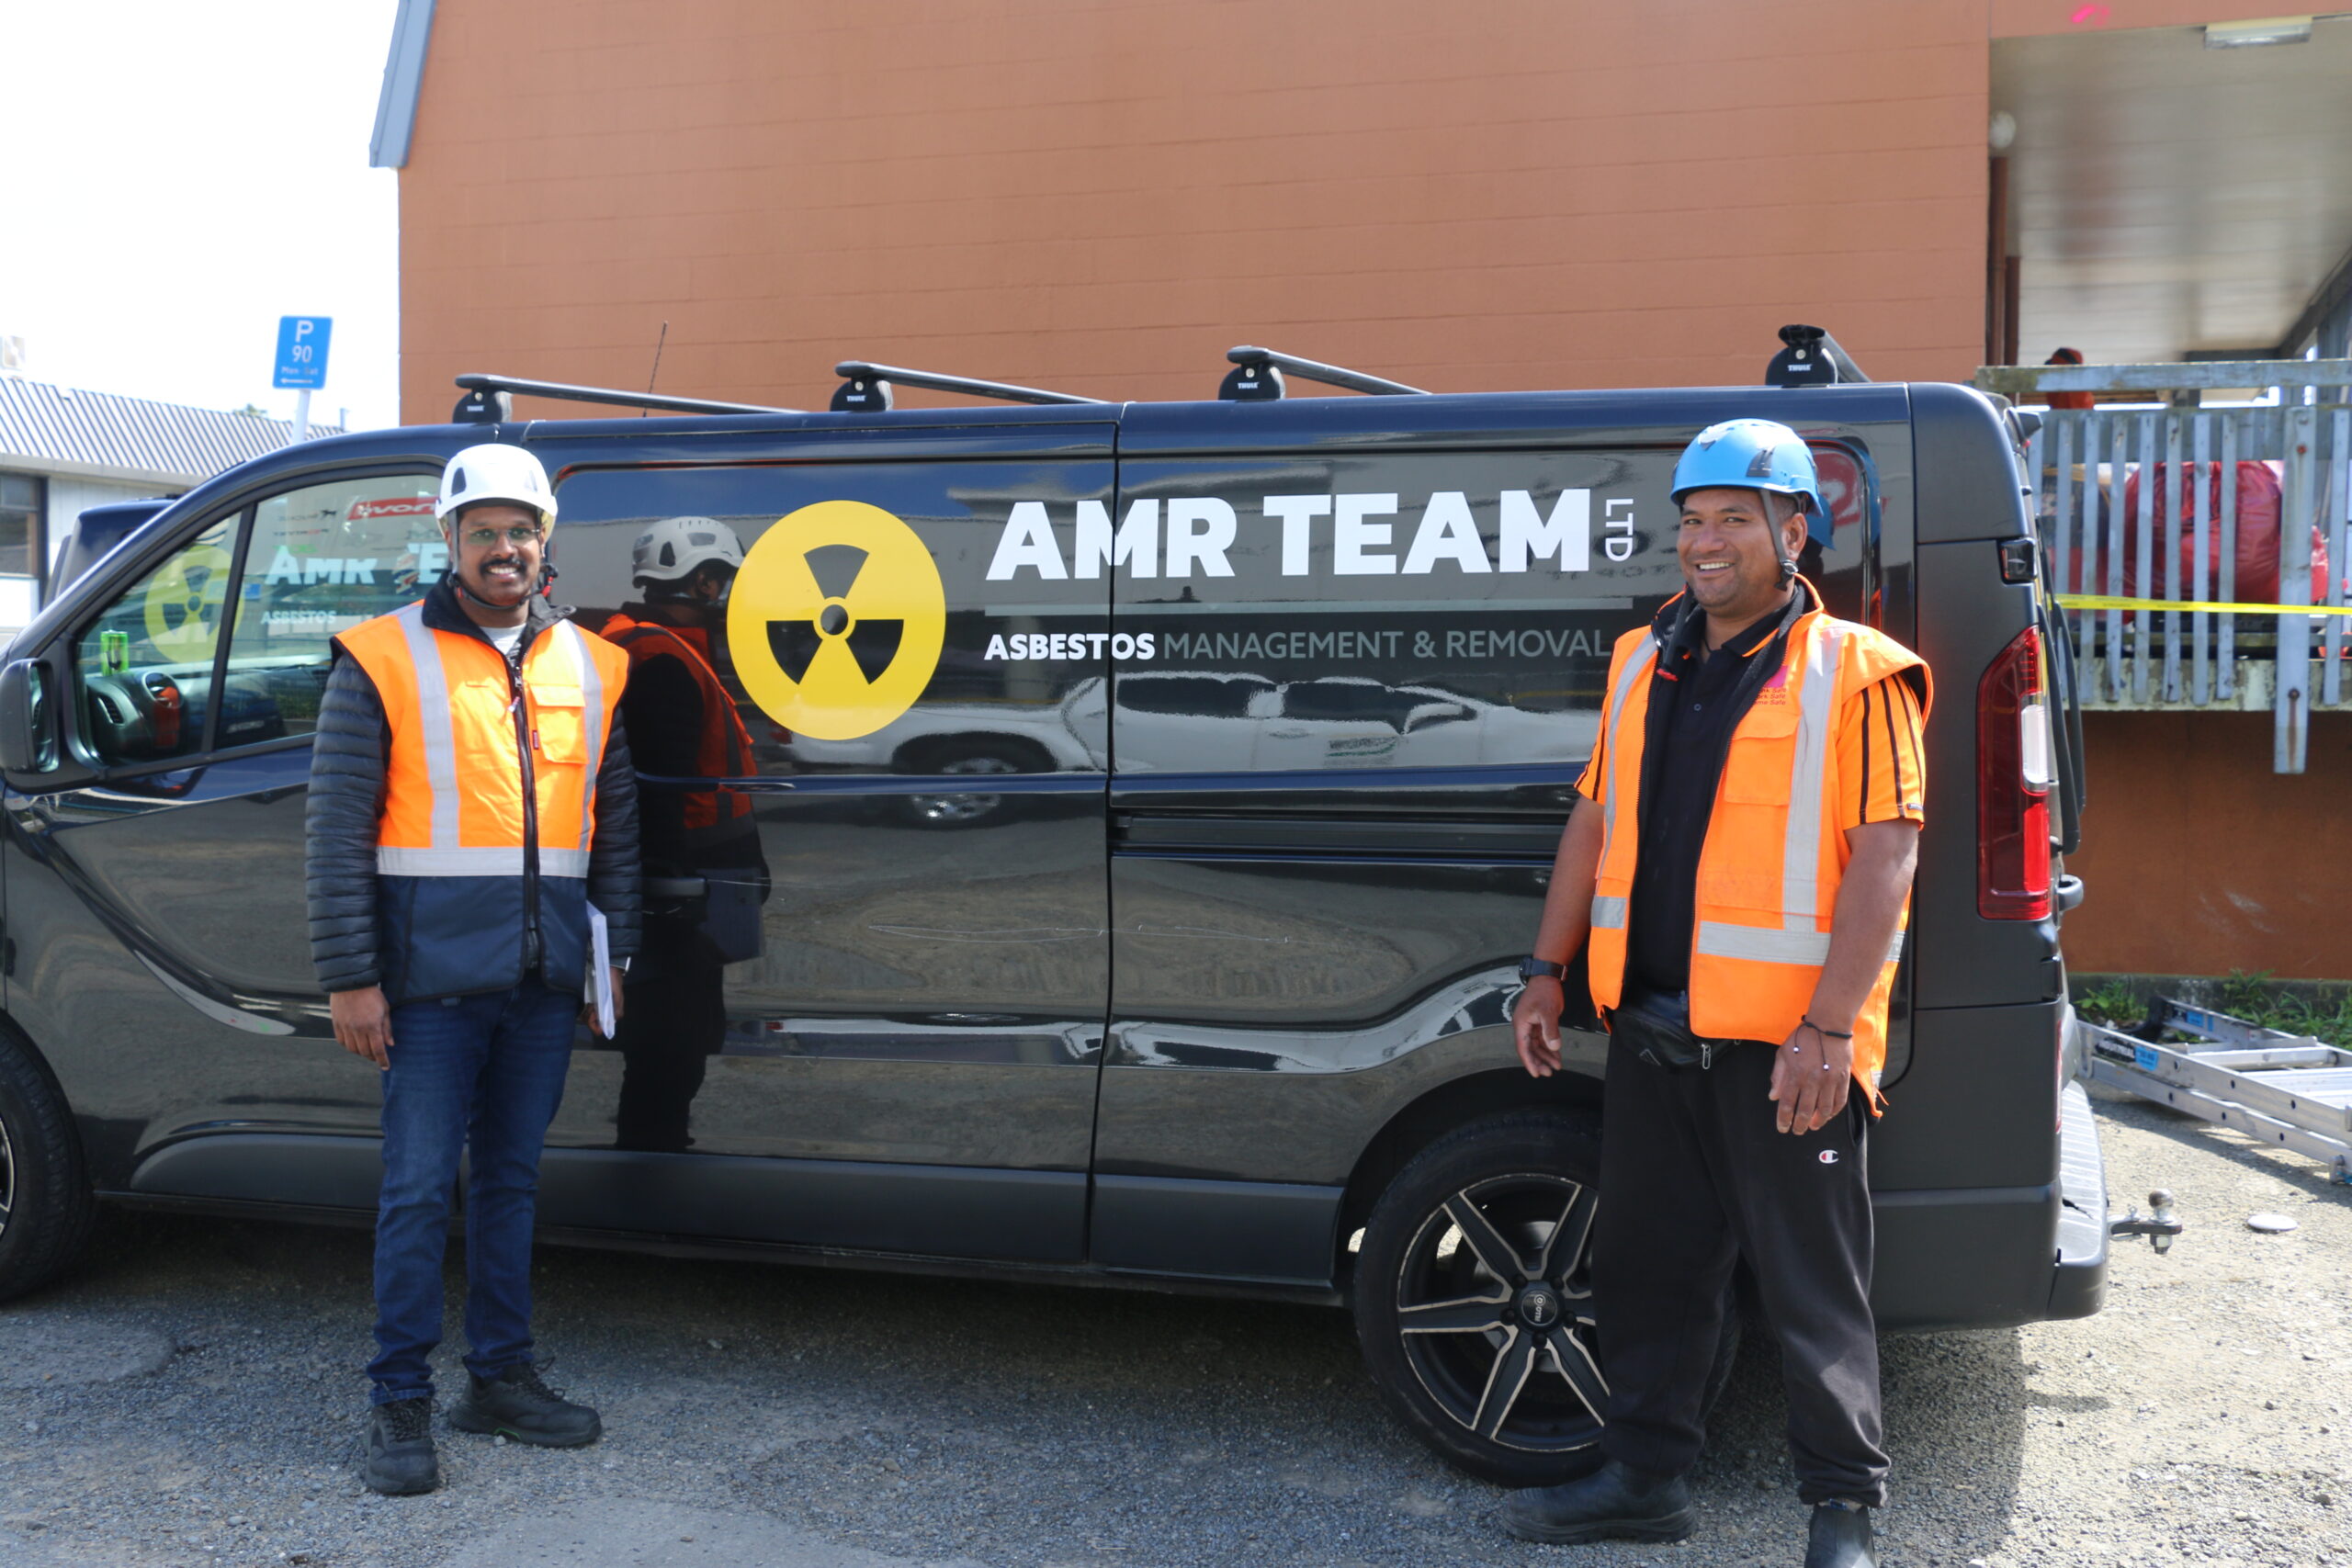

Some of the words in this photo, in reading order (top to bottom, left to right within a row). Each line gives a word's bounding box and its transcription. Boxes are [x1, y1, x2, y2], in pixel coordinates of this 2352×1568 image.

[295, 320, 313, 343] P
[292, 344, 312, 363] 90
[986, 497, 1238, 581] AMR
[1263, 488, 1590, 577] TEAM
[1604, 498, 1634, 561] LTD
[261, 610, 337, 625] ASBESTOS
[984, 632, 1156, 661] ASBESTOS
[1163, 630, 1404, 660] MANAGEMENT
[1413, 630, 1437, 659] &
[1447, 628, 1611, 659] REMOVAL
